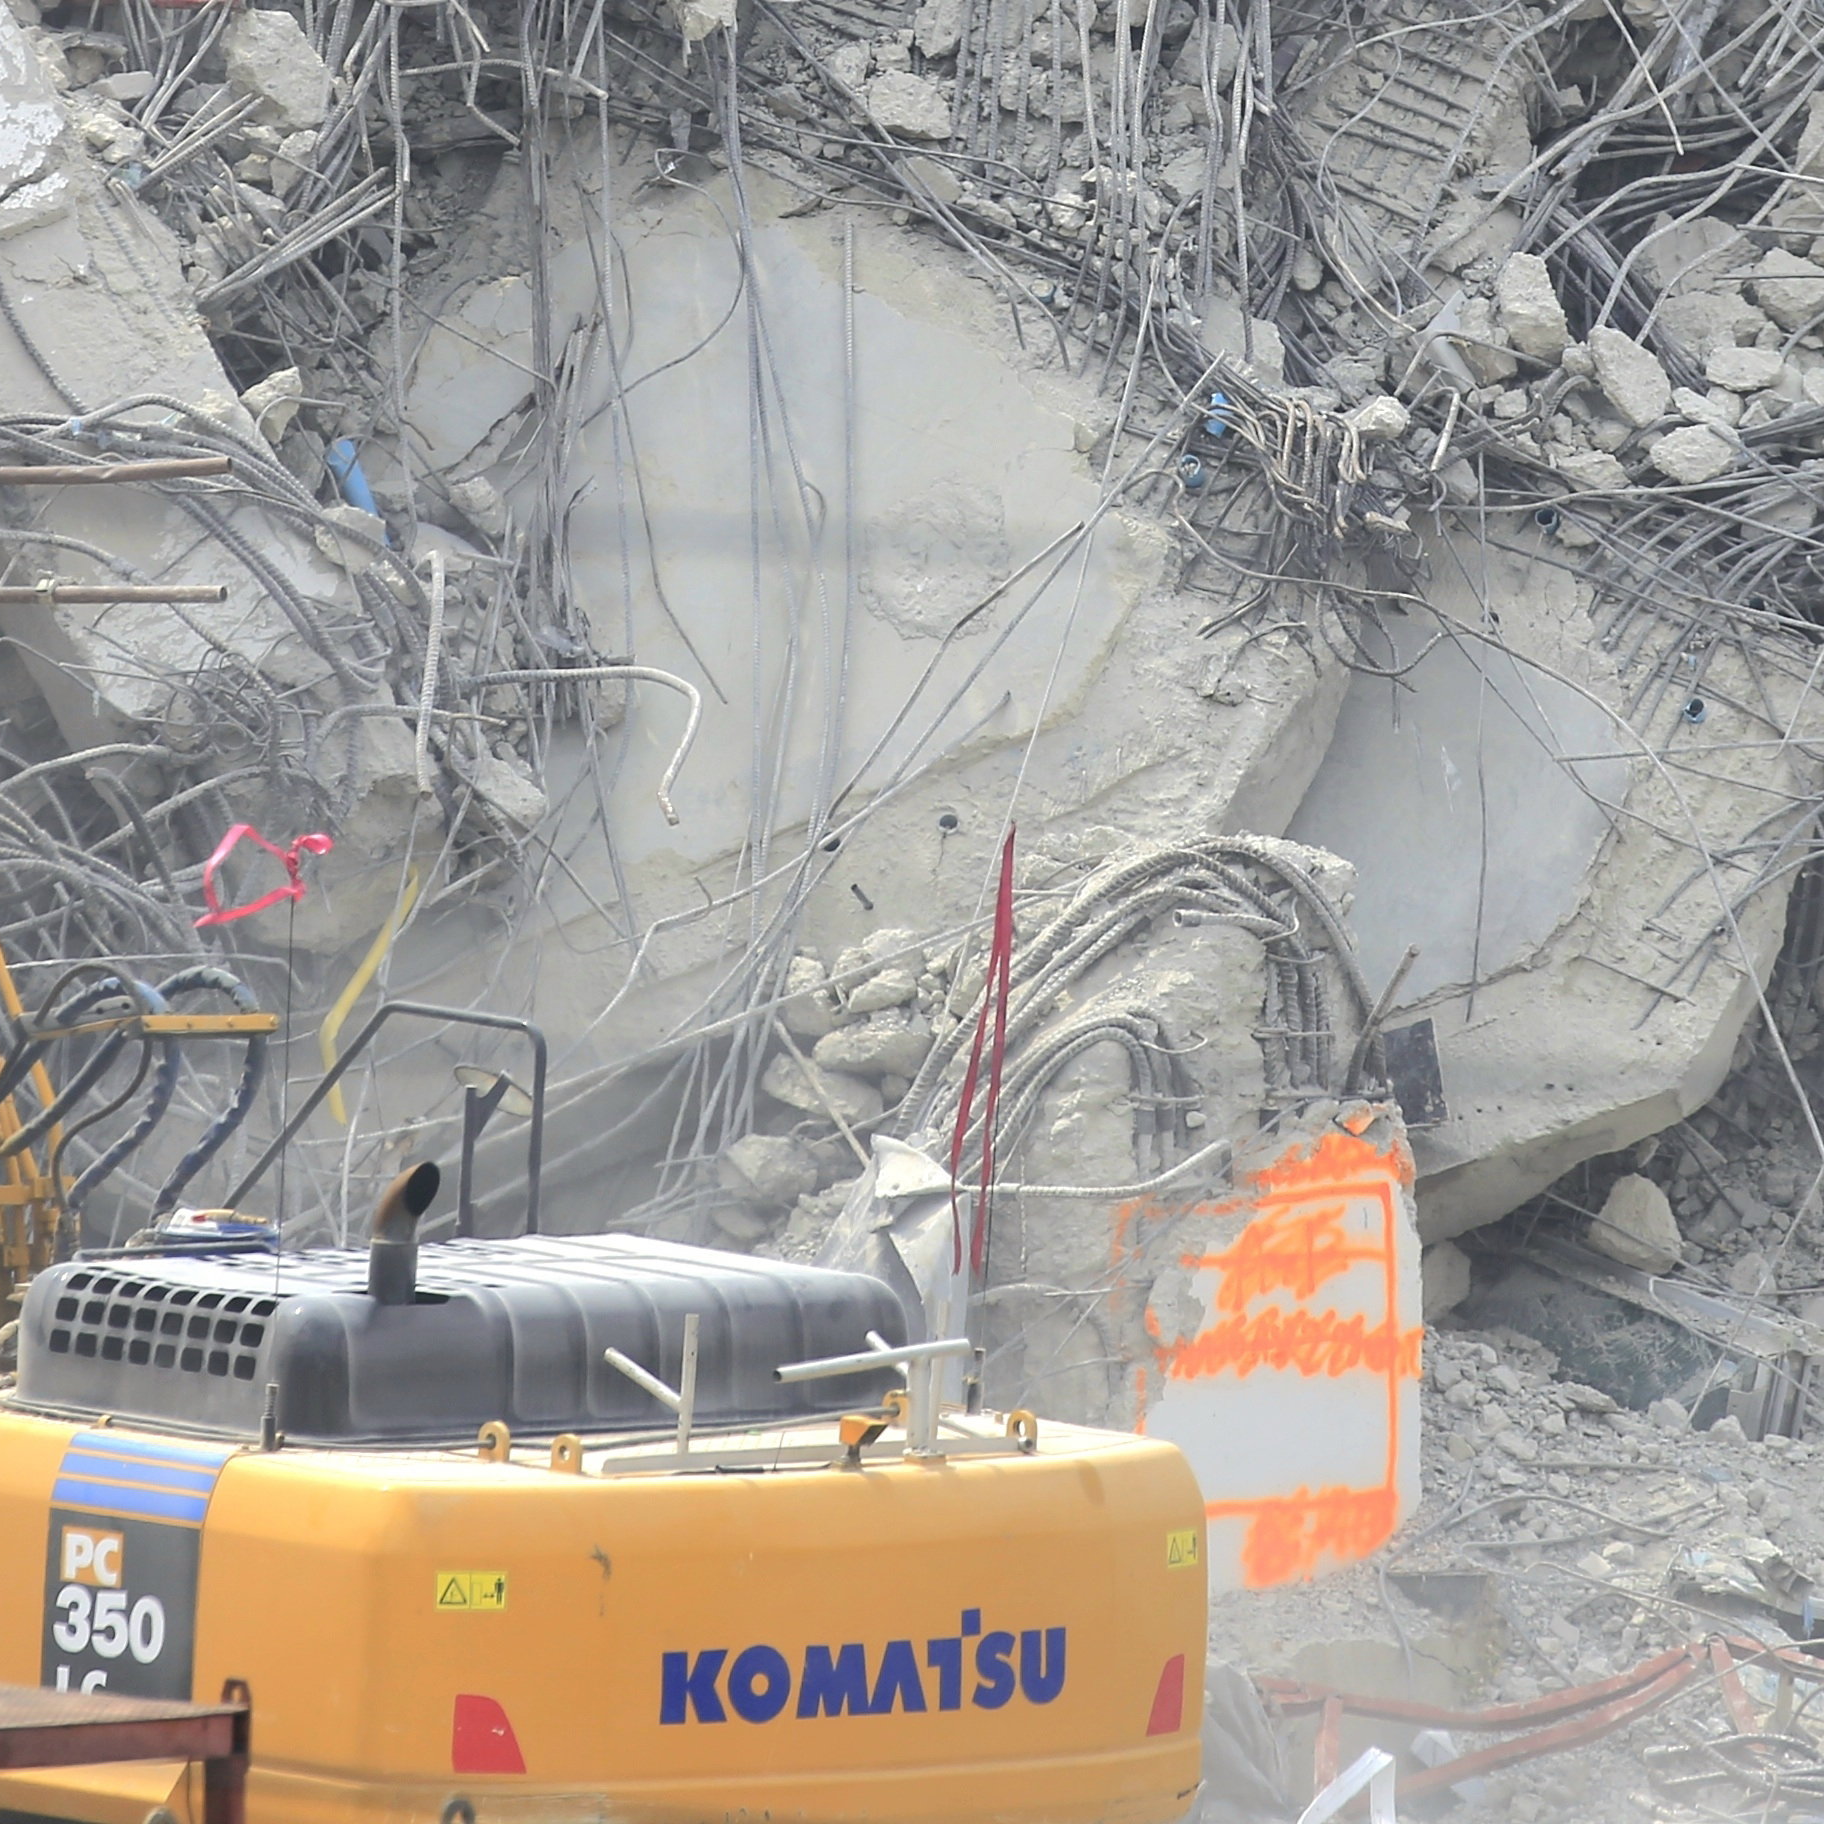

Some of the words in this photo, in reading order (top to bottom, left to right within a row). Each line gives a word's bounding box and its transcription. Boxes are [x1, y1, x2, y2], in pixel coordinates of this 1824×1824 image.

[64, 1532, 119, 1586] PC
[53, 1583, 166, 1664] 350
[659, 1608, 1066, 1725] KOMATSU
